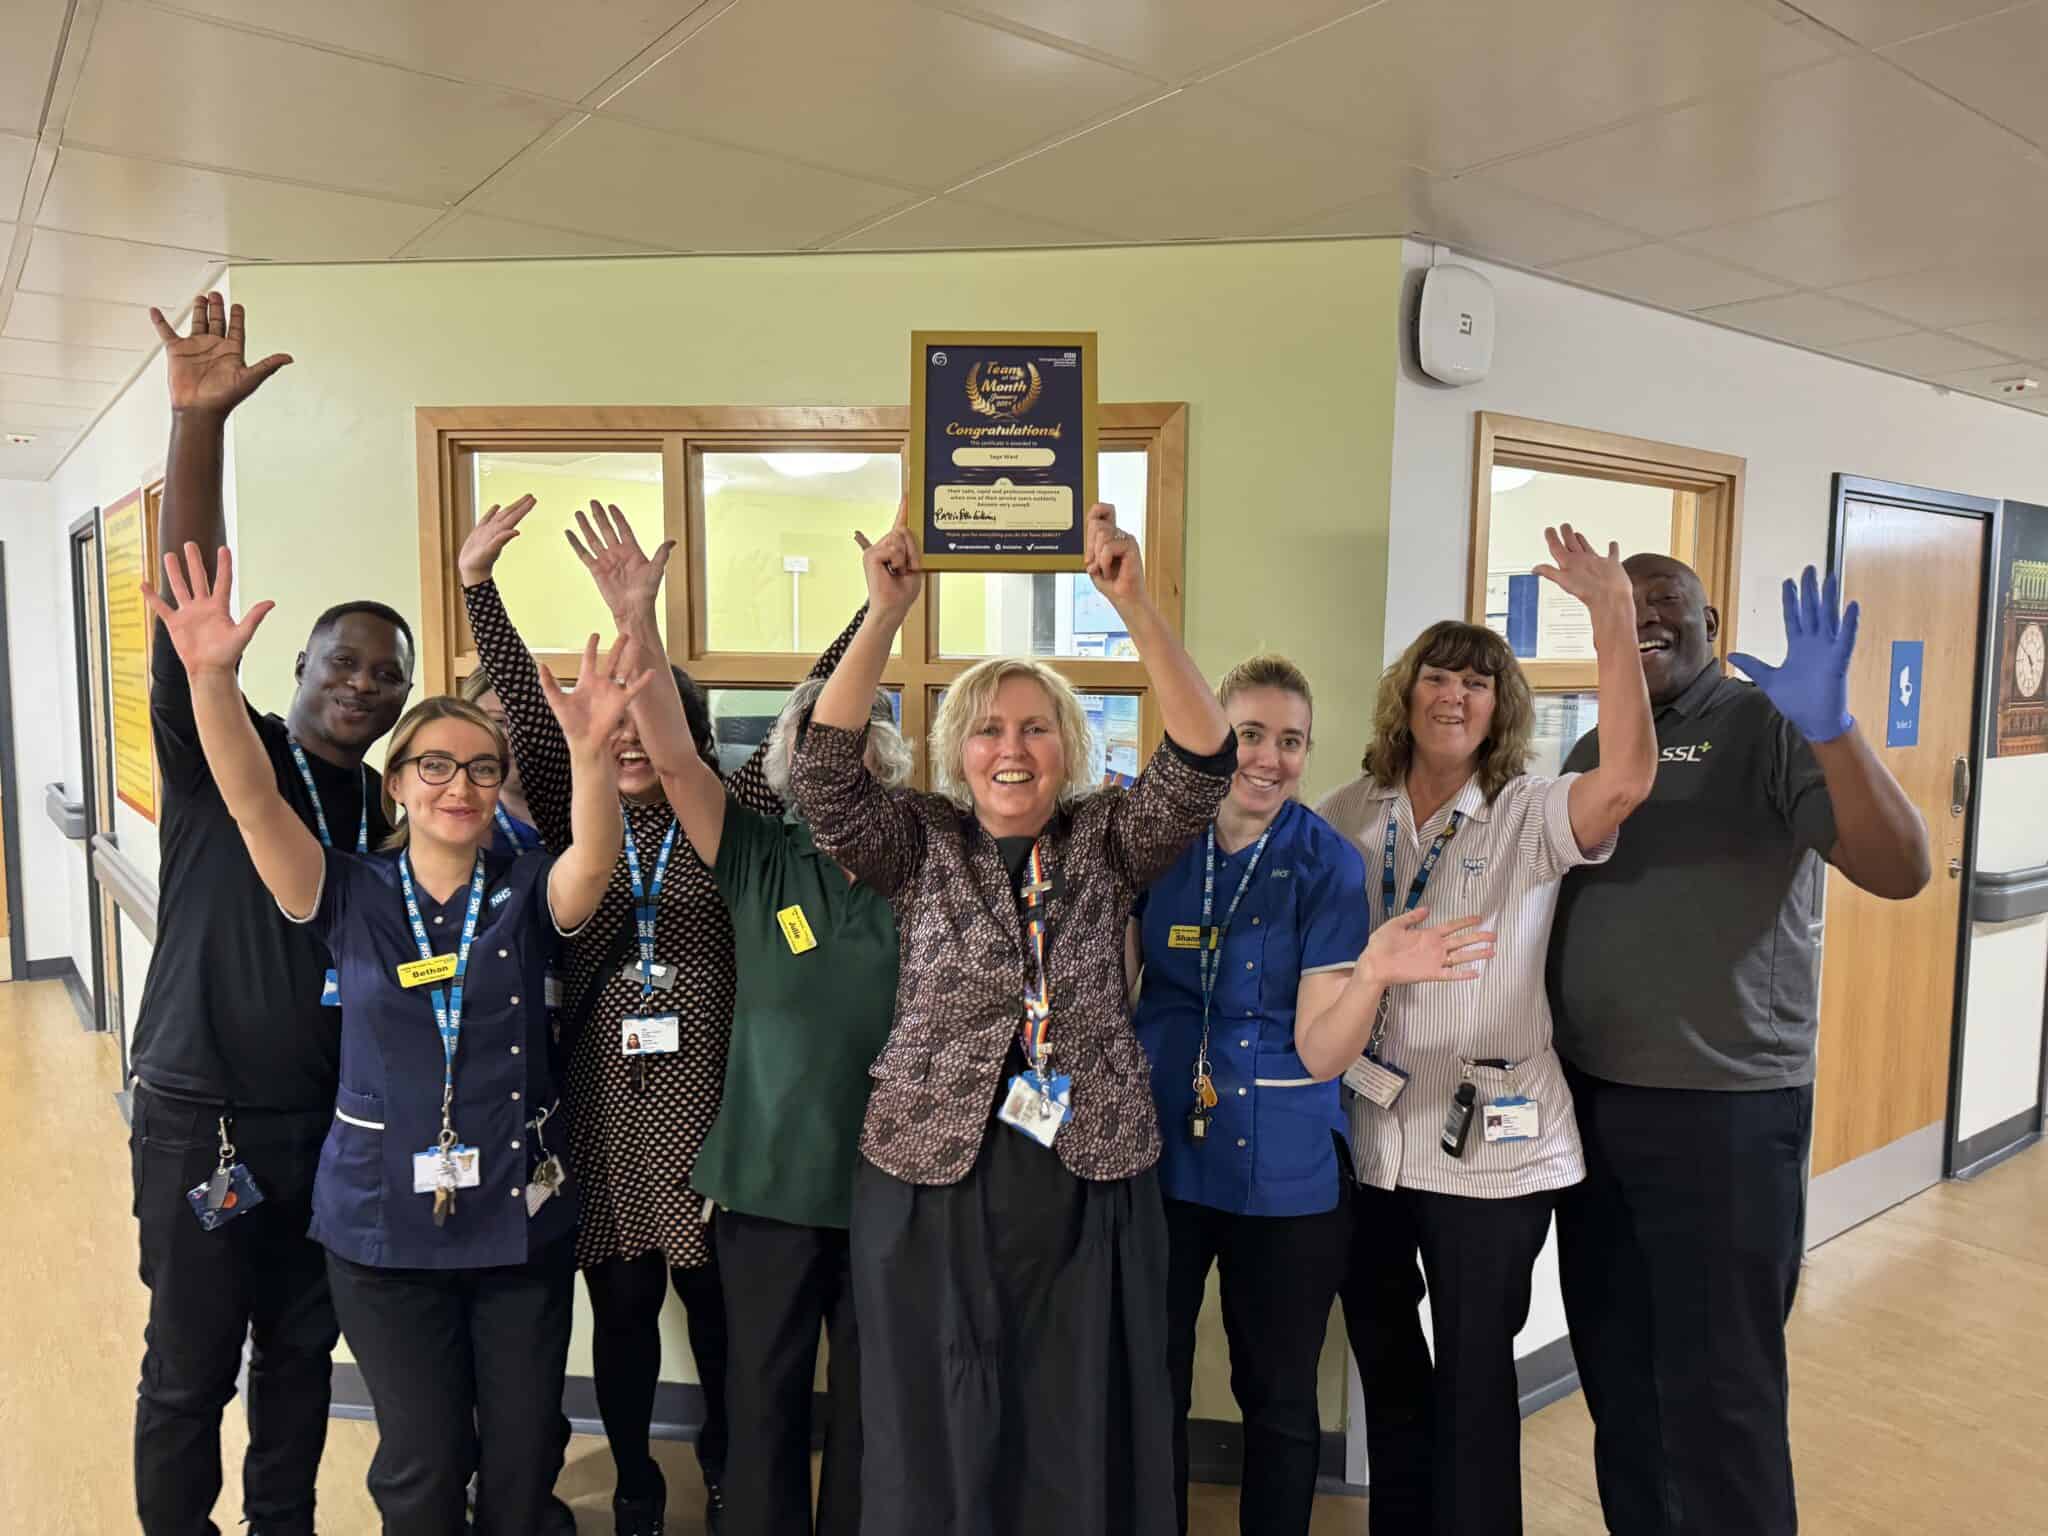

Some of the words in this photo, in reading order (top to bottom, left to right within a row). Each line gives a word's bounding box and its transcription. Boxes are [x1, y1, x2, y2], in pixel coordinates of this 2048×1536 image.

[986, 361, 1022, 376] Team
[981, 379, 1027, 393] Month
[945, 421, 1062, 440] Congratulations!
[1659, 745, 1702, 761] SSL
[490, 887, 512, 907] NHS
[469, 897, 481, 915] NHS
[412, 920, 425, 937] NHS
[412, 965, 449, 978] Bethan
